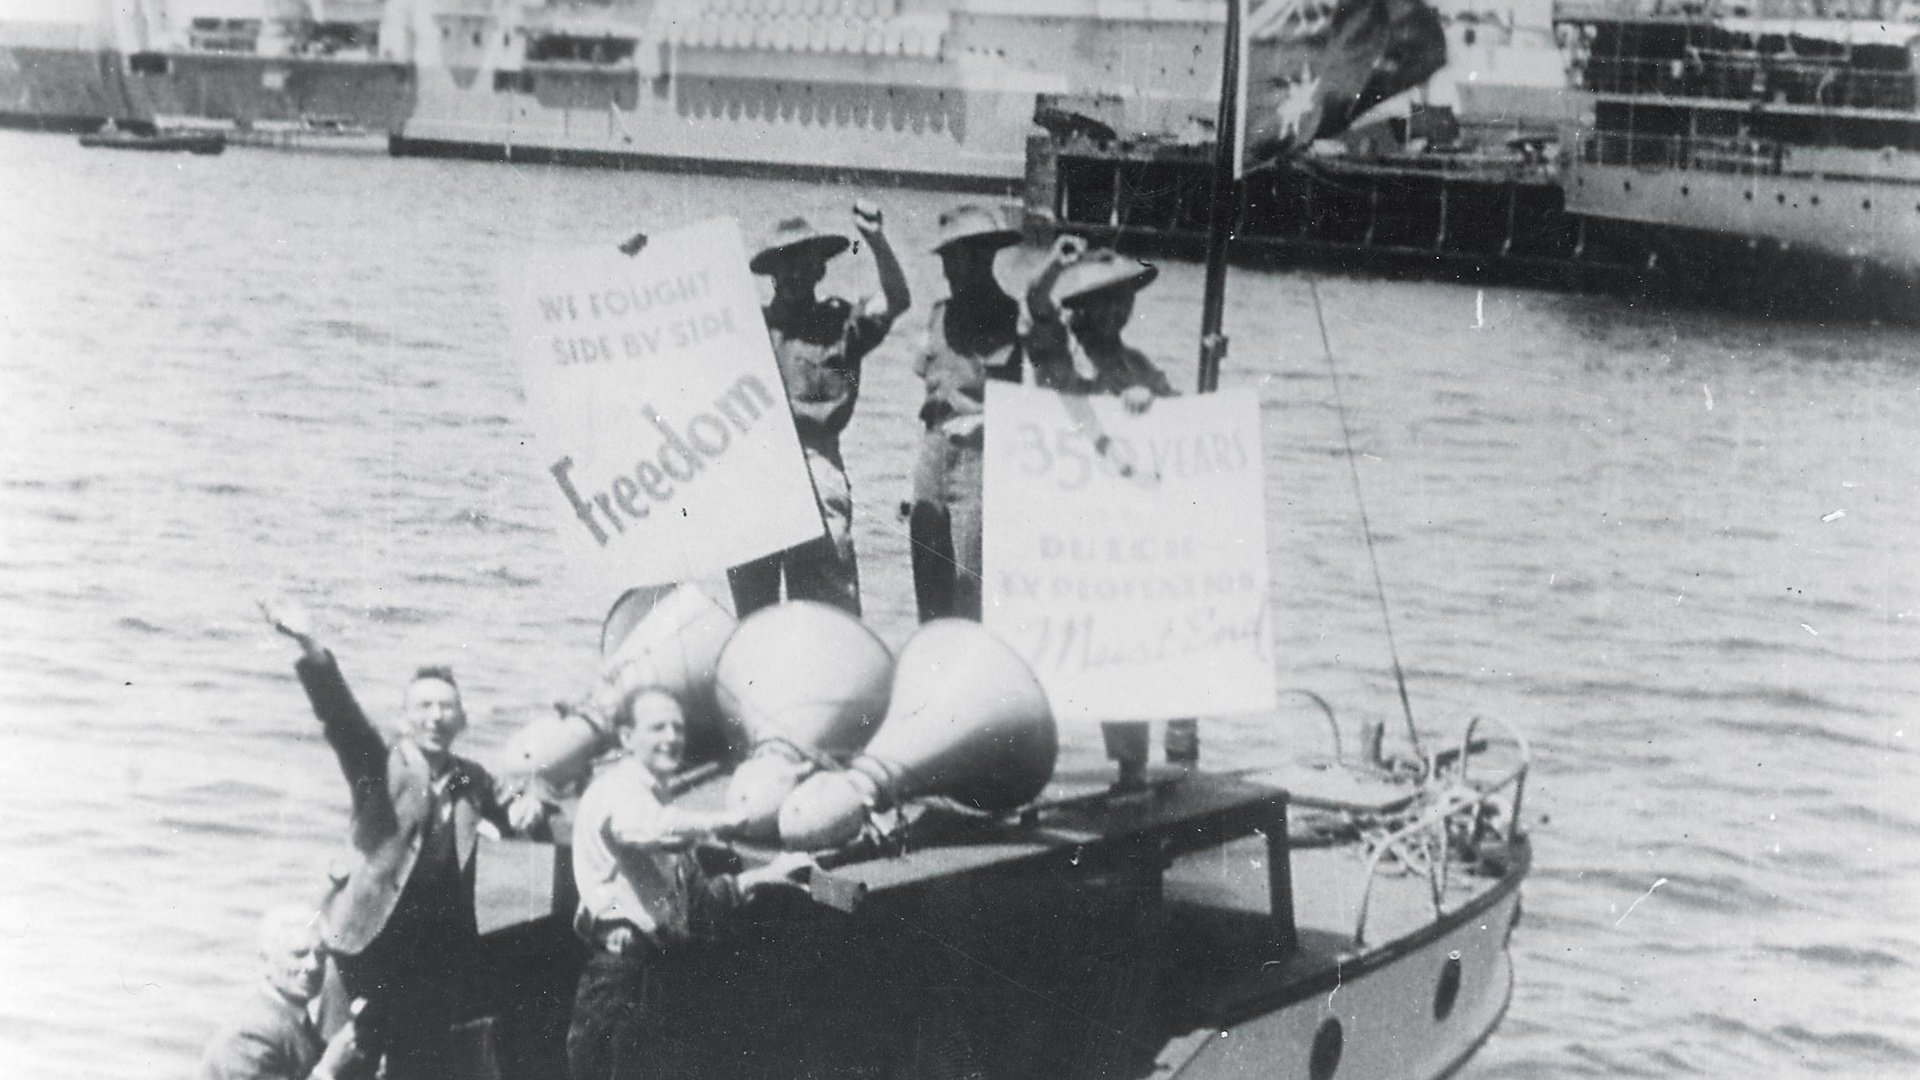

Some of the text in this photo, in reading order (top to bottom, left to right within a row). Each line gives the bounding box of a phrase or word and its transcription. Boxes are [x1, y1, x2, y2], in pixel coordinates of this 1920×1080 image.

[588, 269, 712, 320] FOUGHT
[551, 306, 736, 366] SIDE BY SIDE
[548, 374, 775, 548] Freedom
[1148, 429, 1248, 478] YEARS
[1040, 534, 1194, 561] DUTCH
